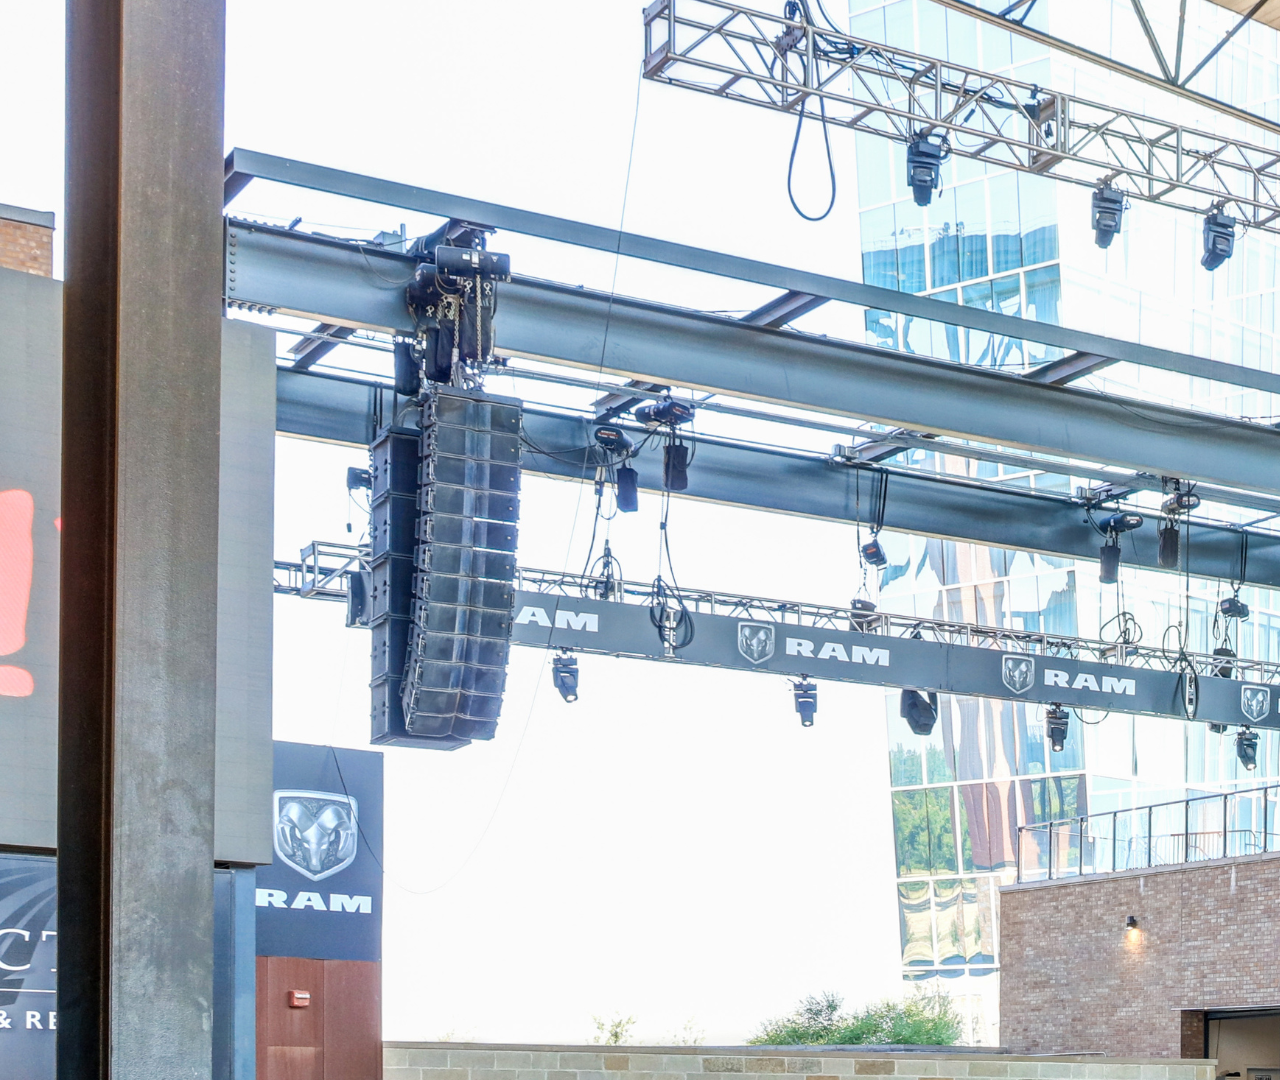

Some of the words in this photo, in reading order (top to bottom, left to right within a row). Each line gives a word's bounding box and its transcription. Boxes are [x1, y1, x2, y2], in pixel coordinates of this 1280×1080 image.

[785, 636, 890, 667] RAM
[1043, 668, 1136, 696] RAM
[254, 887, 373, 914] RAM
